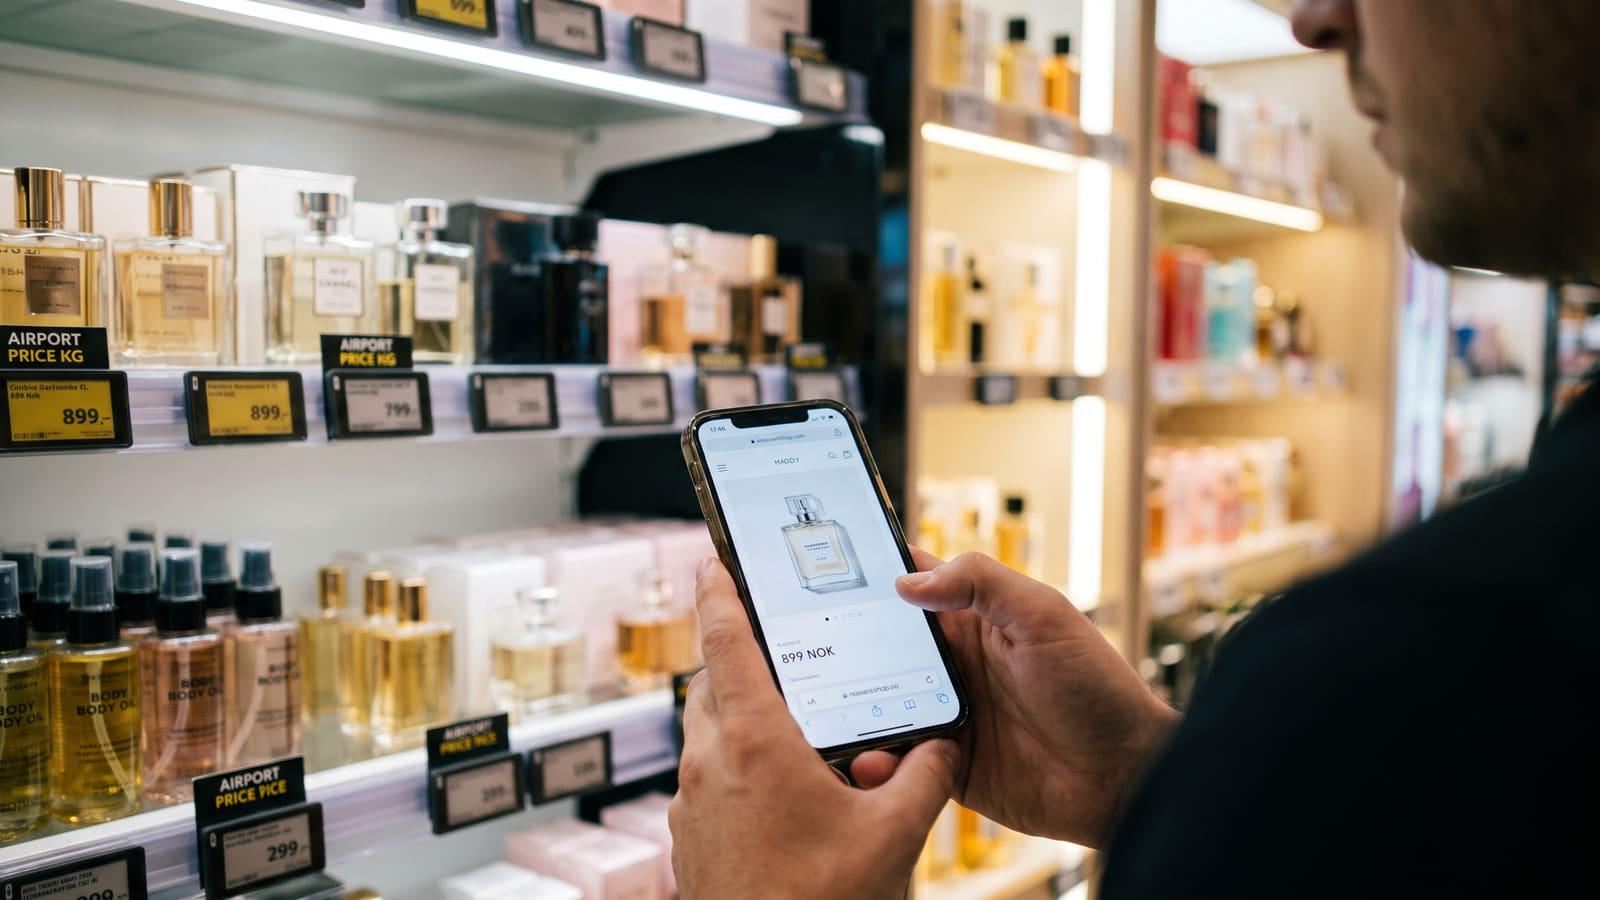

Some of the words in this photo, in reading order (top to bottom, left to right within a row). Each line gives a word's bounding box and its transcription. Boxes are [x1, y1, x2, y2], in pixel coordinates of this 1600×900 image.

[8, 332, 81, 346] AIRPORT
[340, 338, 393, 352] AIRPORT
[8, 349, 57, 362] PRICE
[61, 350, 84, 363] KG
[339, 352, 375, 366] PRICE
[781, 651, 803, 664] 899
[806, 646, 836, 660] NOK
[91, 688, 128, 703] BODY
[168, 689, 205, 701] BODY
[77, 703, 116, 716] BODY
[26, 711, 44, 725] OIL
[220, 766, 281, 793] AIRPORT
[215, 787, 256, 809] PRICE
[267, 841, 298, 862] 299
